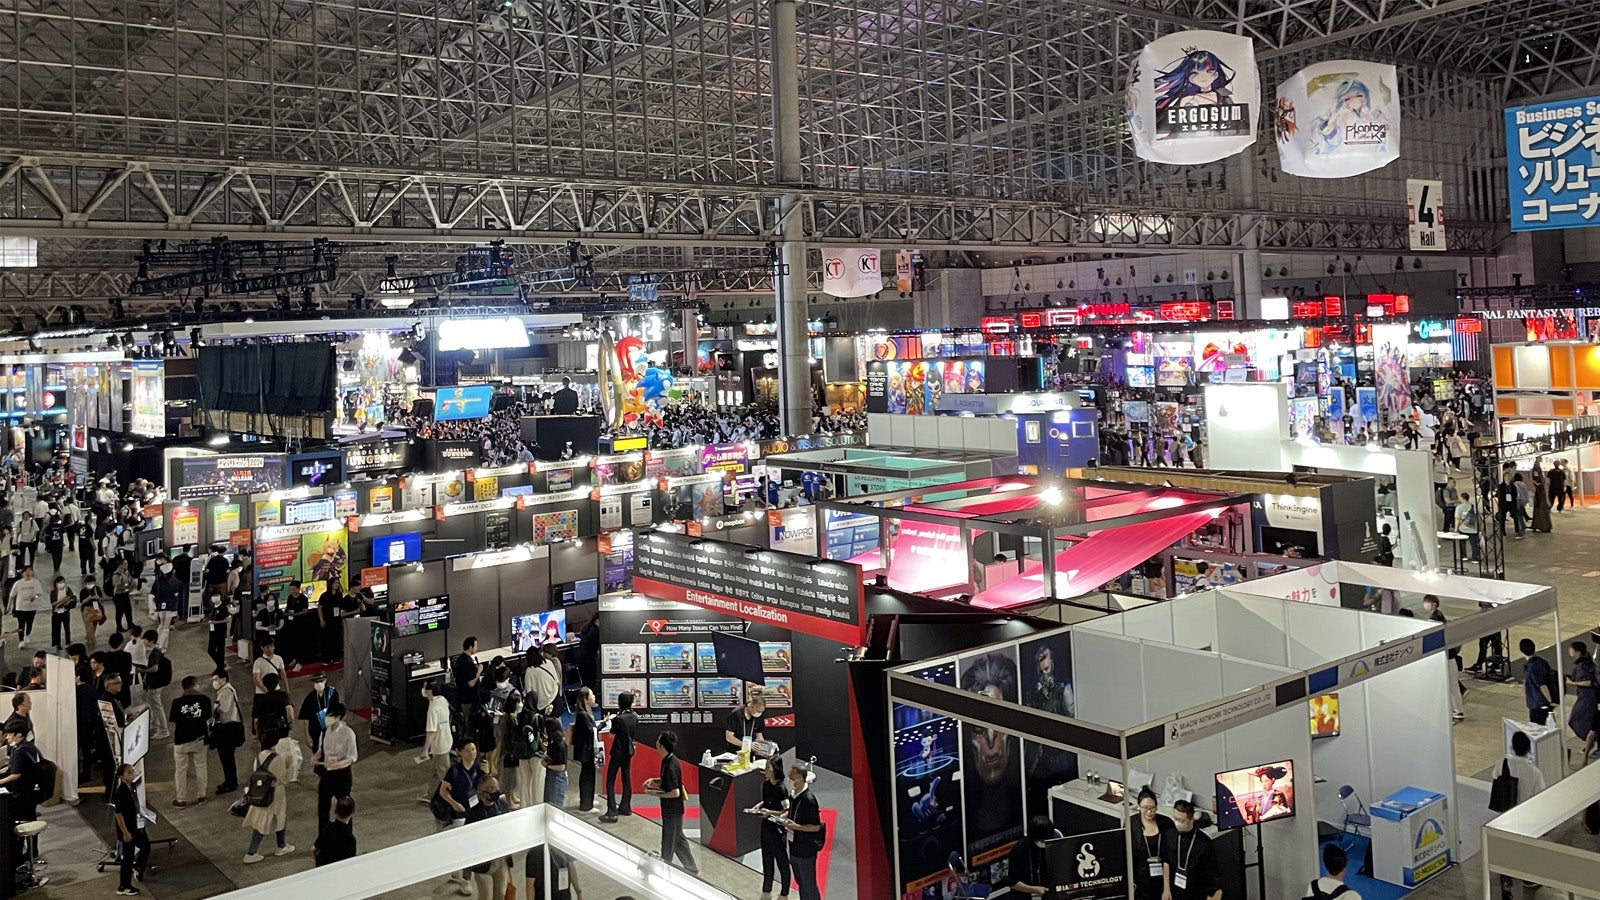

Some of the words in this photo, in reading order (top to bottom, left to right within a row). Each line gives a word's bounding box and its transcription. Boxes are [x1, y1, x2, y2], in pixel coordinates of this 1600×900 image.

[1168, 105, 1241, 124] ERGOSUM
[1516, 108, 1582, 125] Business
[1419, 186, 1434, 228] 4
[1420, 231, 1435, 246] Hall
[862, 257, 877, 271] KT
[1077, 303, 1130, 316] KONAMI
[1472, 310, 1504, 320] NAL
[1506, 308, 1558, 319] FANTASY
[762, 442, 789, 454] AUDIO
[797, 439, 825, 449] VISUAL
[825, 434, 864, 446] SOLUTION
[347, 448, 393, 457] ENDLESS
[1271, 502, 1318, 514] ThinkEngine
[723, 518, 745, 527] mapbox
[780, 527, 813, 540] NOWPRO
[686, 591, 738, 612] Entertainment
[739, 601, 787, 623] Localization
[1080, 875, 1123, 888] TECHNOLOGY
